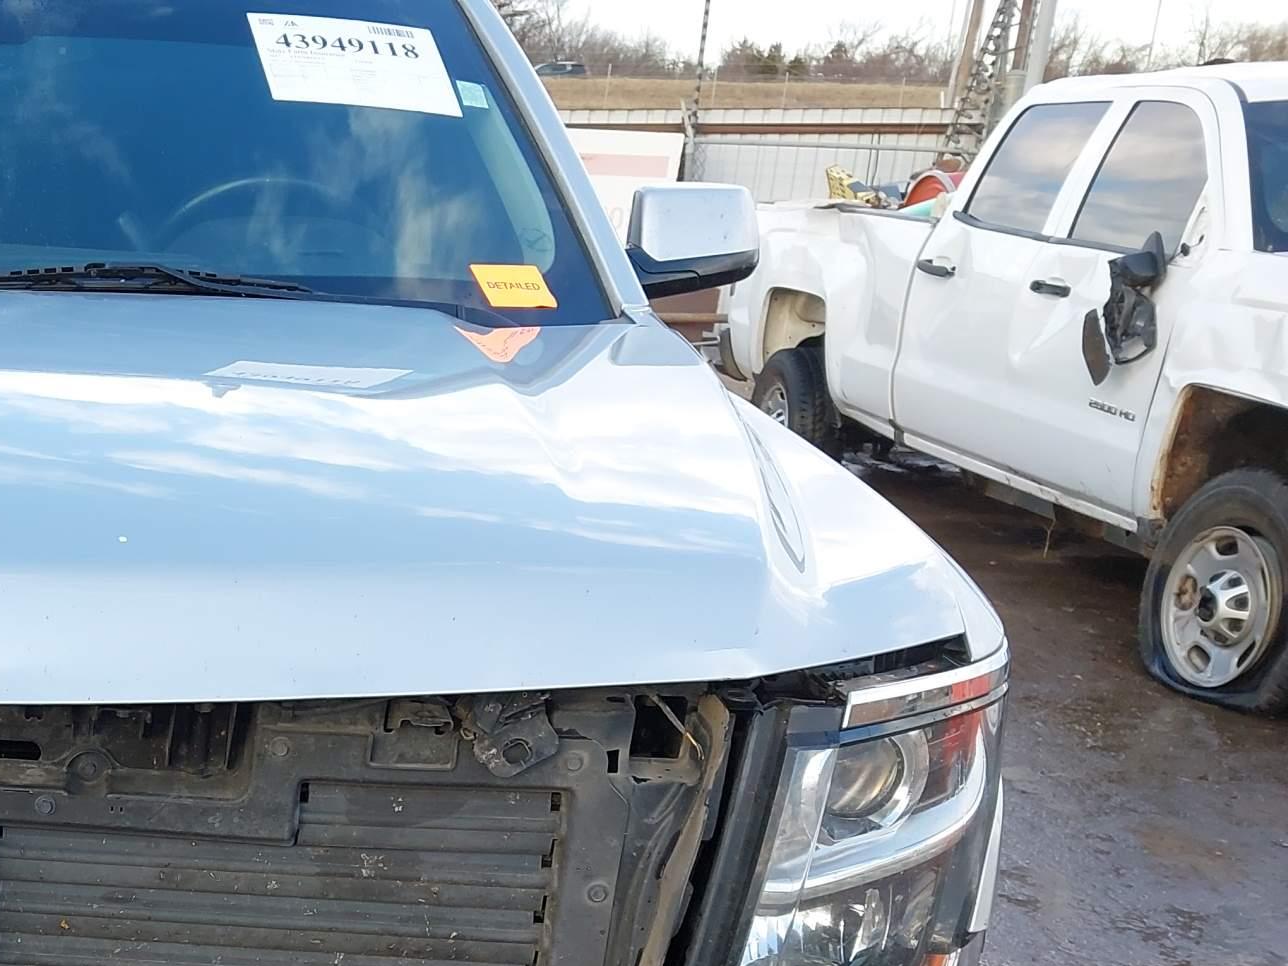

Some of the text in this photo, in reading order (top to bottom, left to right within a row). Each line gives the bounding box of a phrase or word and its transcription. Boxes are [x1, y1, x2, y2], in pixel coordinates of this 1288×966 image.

[275, 32, 420, 60] 43949118
[486, 281, 541, 291] DETAILED
[1088, 400, 1136, 422] 2500 HD
